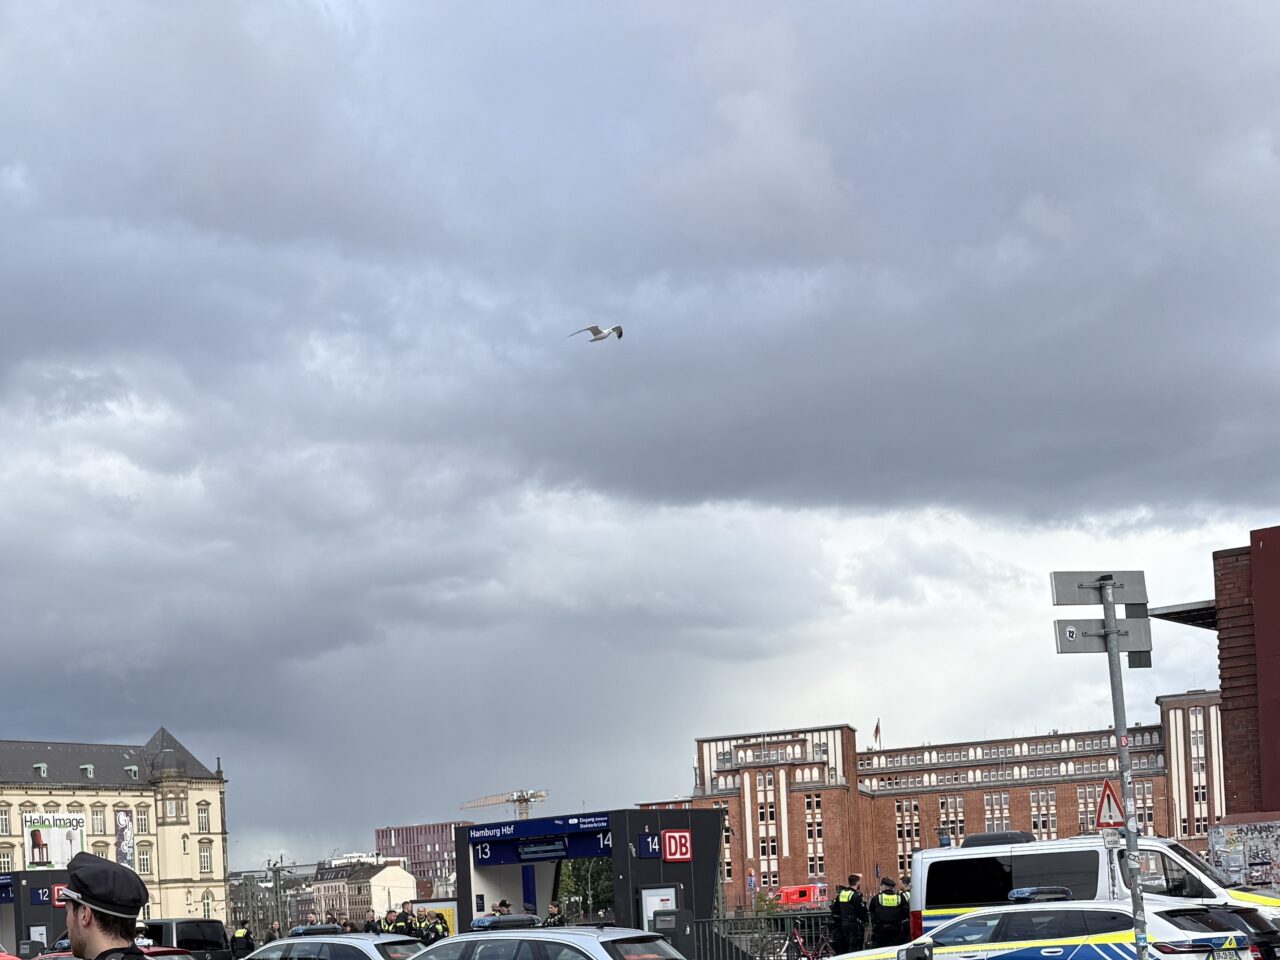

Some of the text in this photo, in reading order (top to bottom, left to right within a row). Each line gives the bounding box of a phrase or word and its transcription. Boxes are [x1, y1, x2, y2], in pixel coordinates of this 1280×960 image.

[24, 815, 85, 831] Hello Image
[470, 824, 515, 838] Hamburg Hbf
[596, 831, 613, 849] 14
[646, 835, 660, 853] 14
[667, 834, 689, 857] DB
[475, 842, 491, 859] 13
[37, 888, 50, 901] 12
